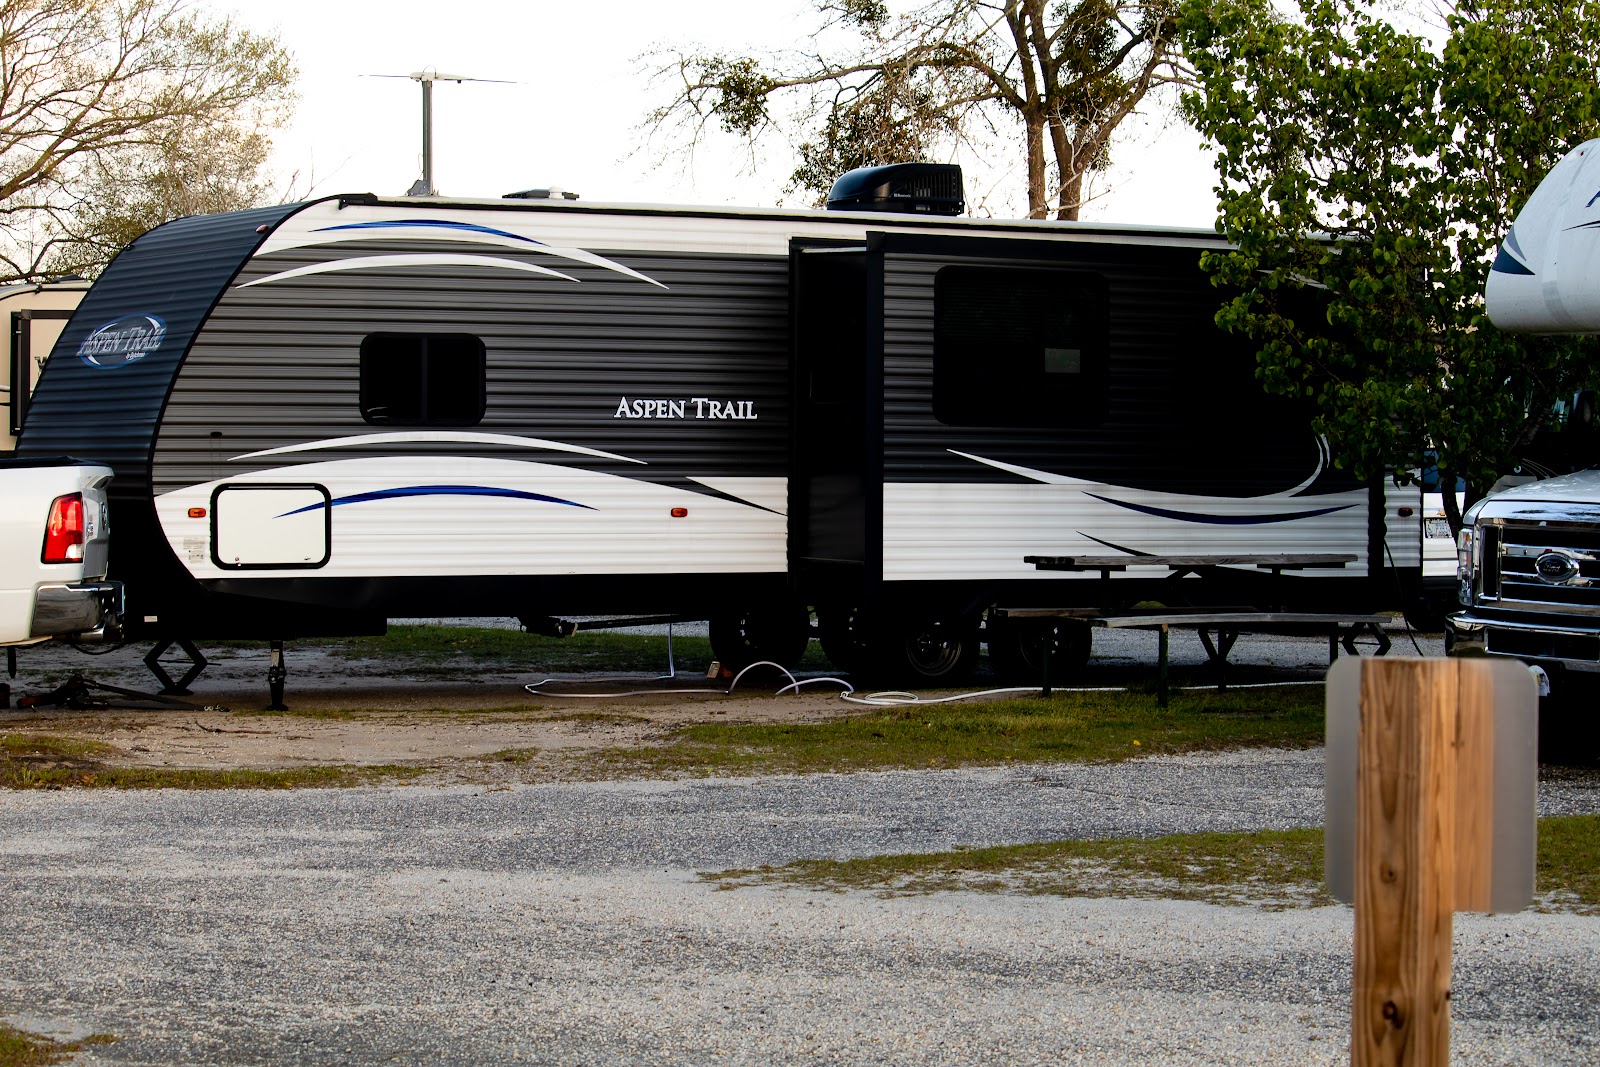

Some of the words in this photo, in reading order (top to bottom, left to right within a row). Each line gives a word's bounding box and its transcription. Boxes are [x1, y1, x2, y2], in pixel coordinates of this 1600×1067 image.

[76, 330, 127, 356] ASPEN
[121, 327, 167, 352] TRAIL
[613, 396, 687, 419] ASPEN
[691, 397, 758, 419] TRAIL
